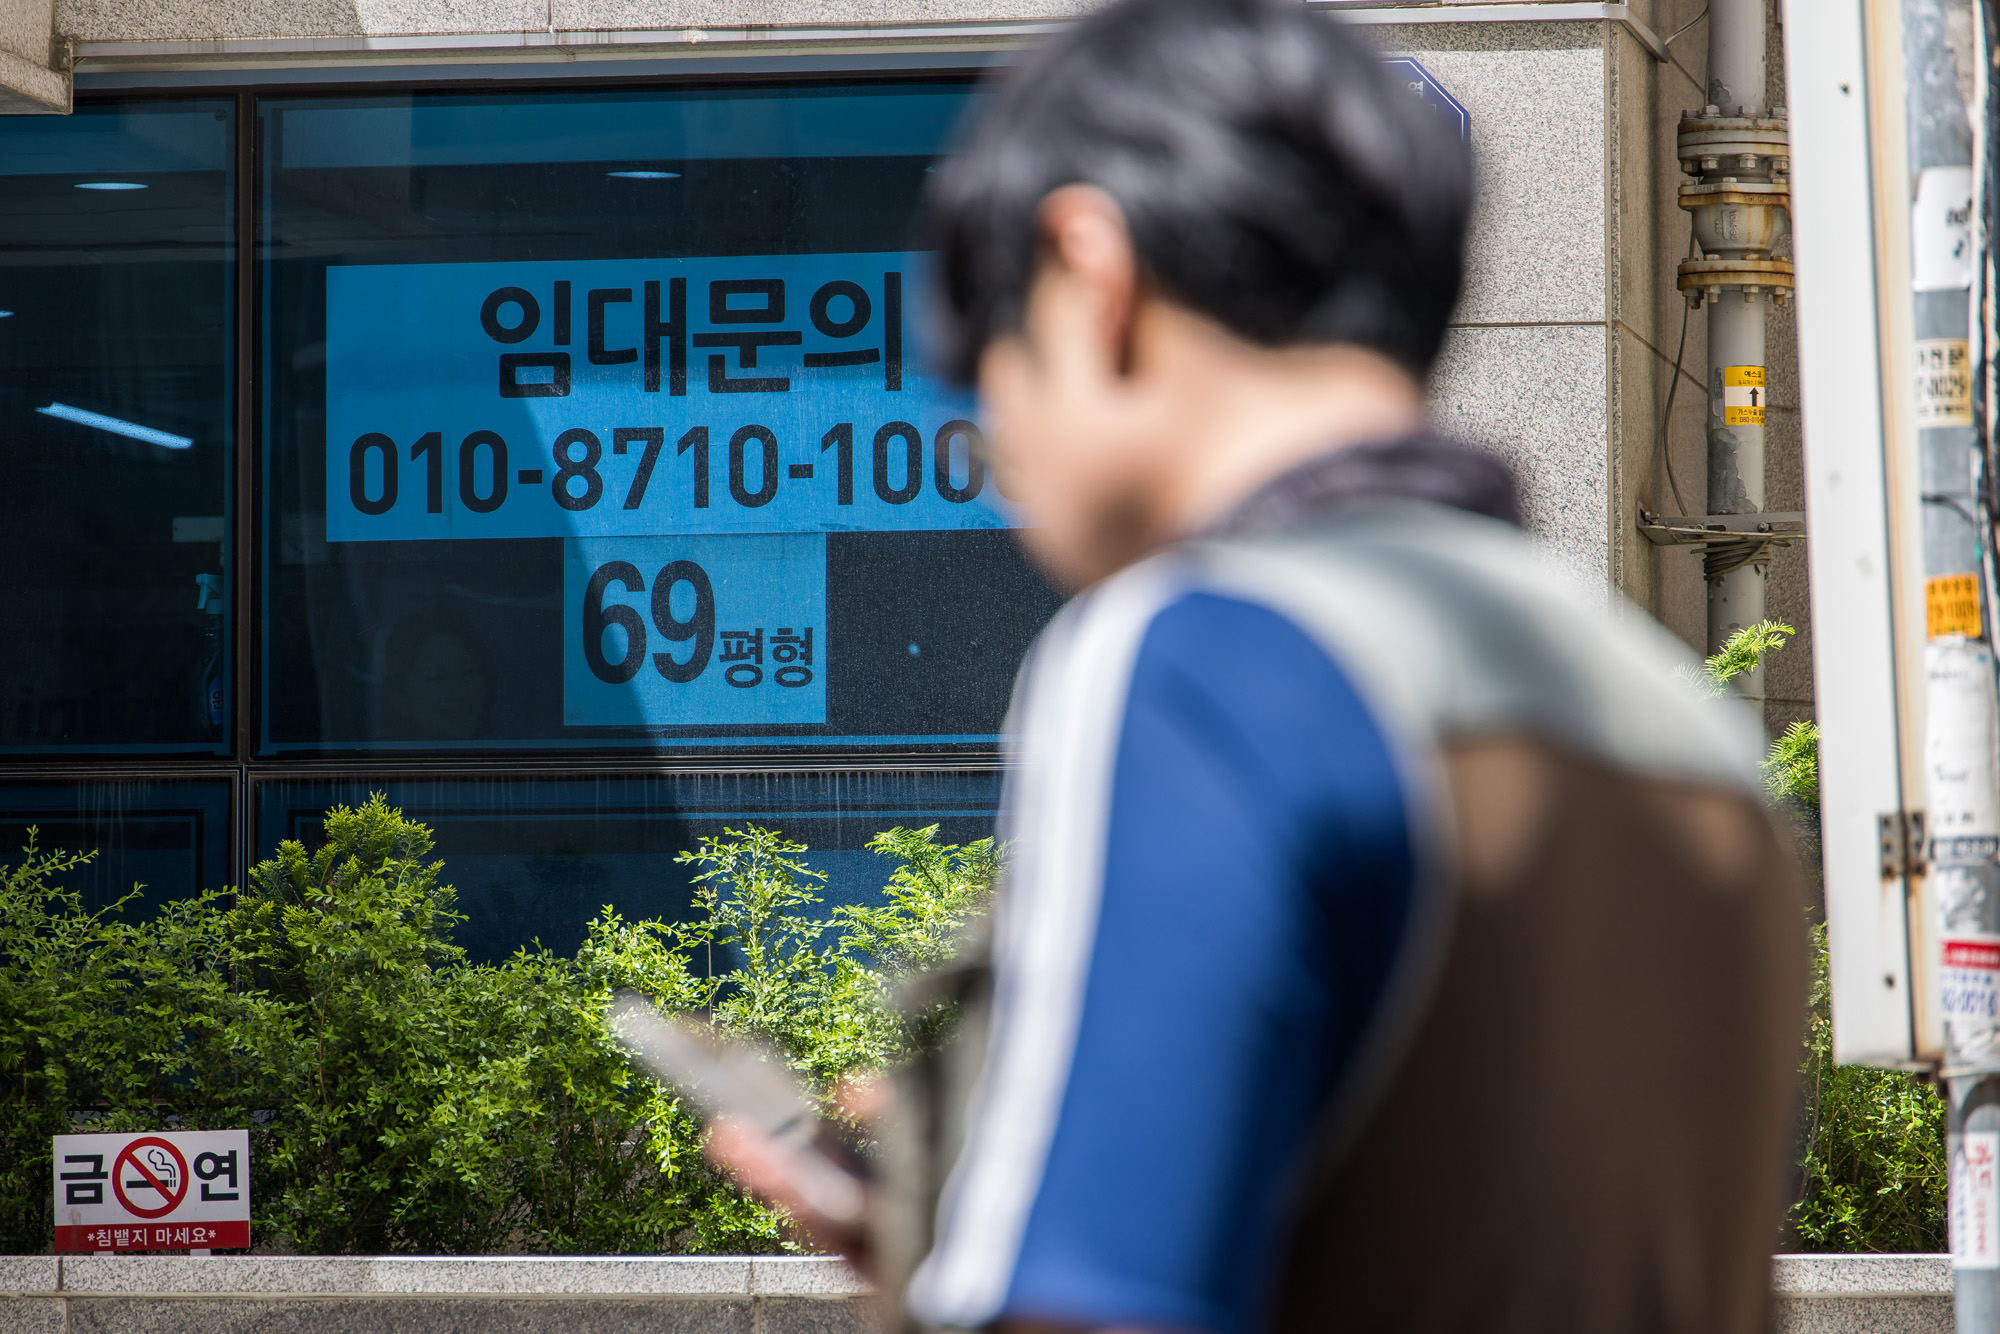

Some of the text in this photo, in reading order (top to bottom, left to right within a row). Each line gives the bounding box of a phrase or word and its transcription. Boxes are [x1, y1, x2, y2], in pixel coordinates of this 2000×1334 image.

[480, 271, 903, 399] 임대문의
[1743, 370, 1762, 378] 예스코
[348, 419, 1022, 517] 010-8710-100
[60, 1150, 240, 1205] 금 연
